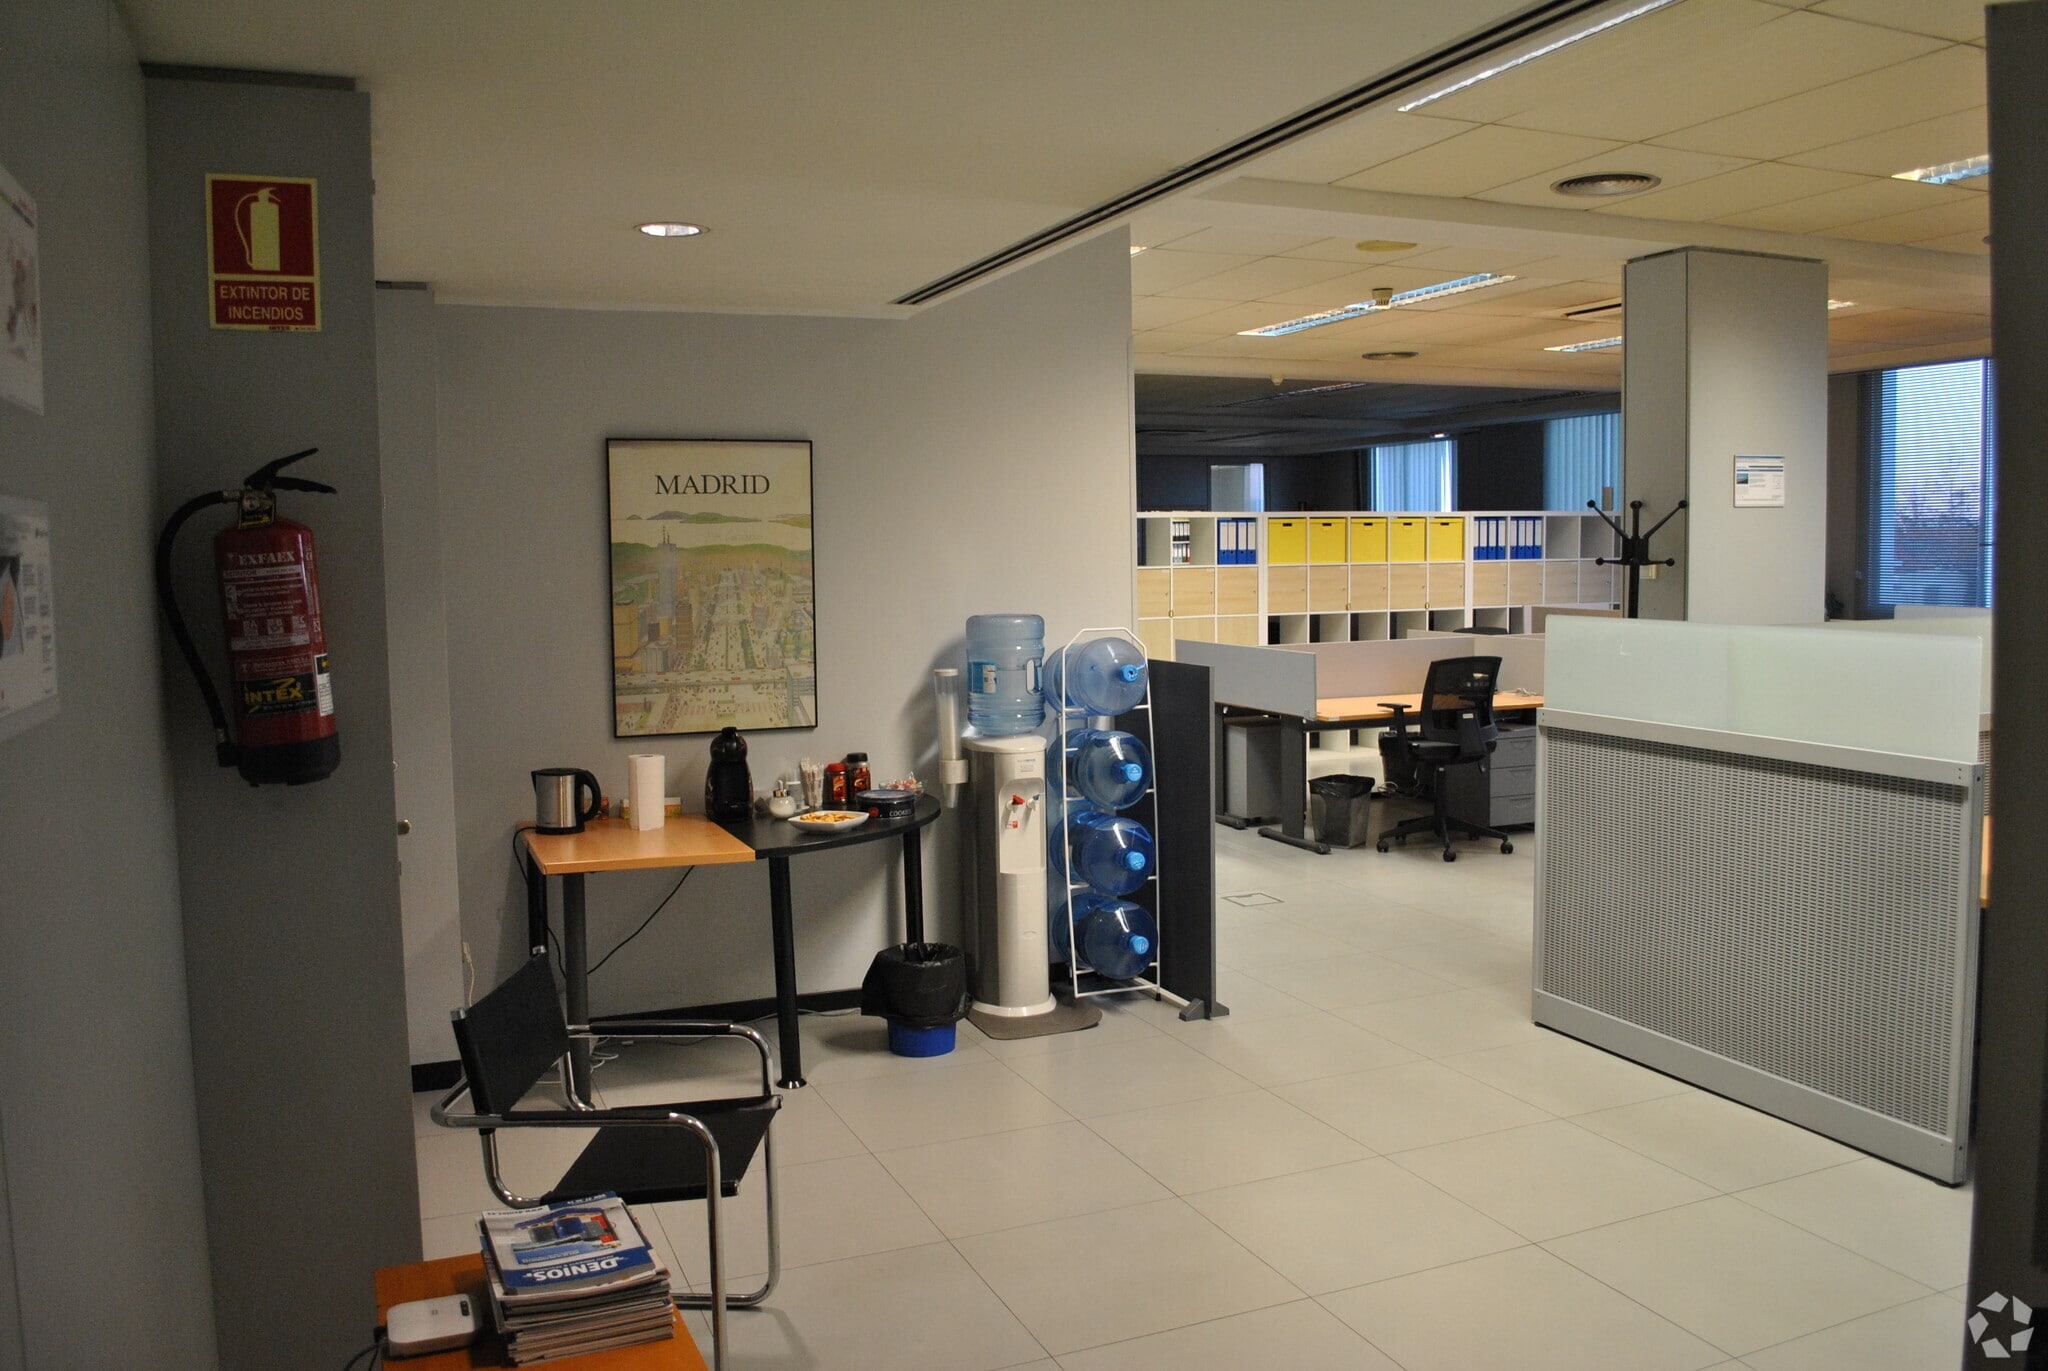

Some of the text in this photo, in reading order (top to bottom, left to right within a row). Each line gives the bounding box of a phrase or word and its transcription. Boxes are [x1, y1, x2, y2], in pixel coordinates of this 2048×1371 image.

[220, 285, 311, 301] EXTINTOR DE
[229, 306, 304, 321] INCENDIOS
[654, 474, 770, 495] MADRID
[244, 688, 304, 704] INTEX
